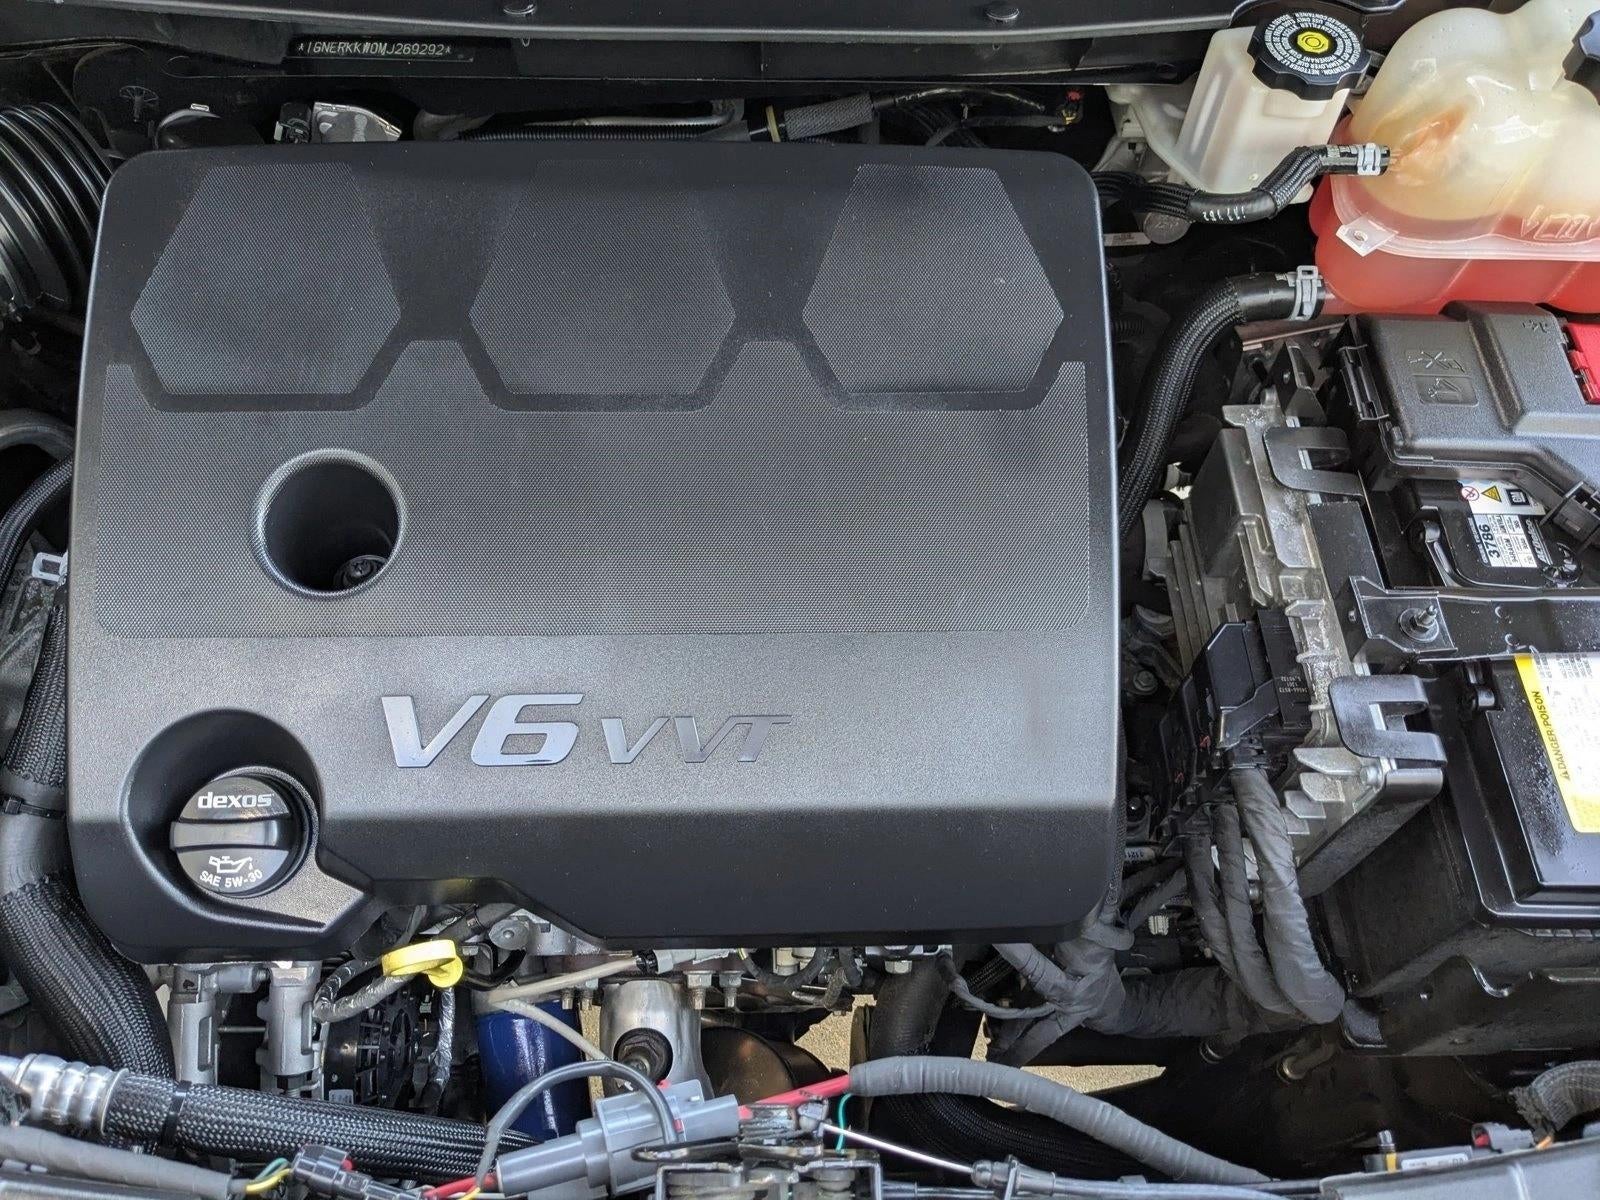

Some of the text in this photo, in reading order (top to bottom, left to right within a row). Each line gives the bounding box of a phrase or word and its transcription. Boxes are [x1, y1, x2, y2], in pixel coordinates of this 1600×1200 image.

[1289, 63, 1320, 75] NETTOYER
[1509, 491, 1523, 503] GM
[1478, 524, 1500, 558] 3786
[1525, 519, 1546, 562] ACDelco
[382, 693, 792, 768] V6 VVT
[198, 792, 272, 809] dexos
[200, 870, 263, 888] SAE 5W-30
